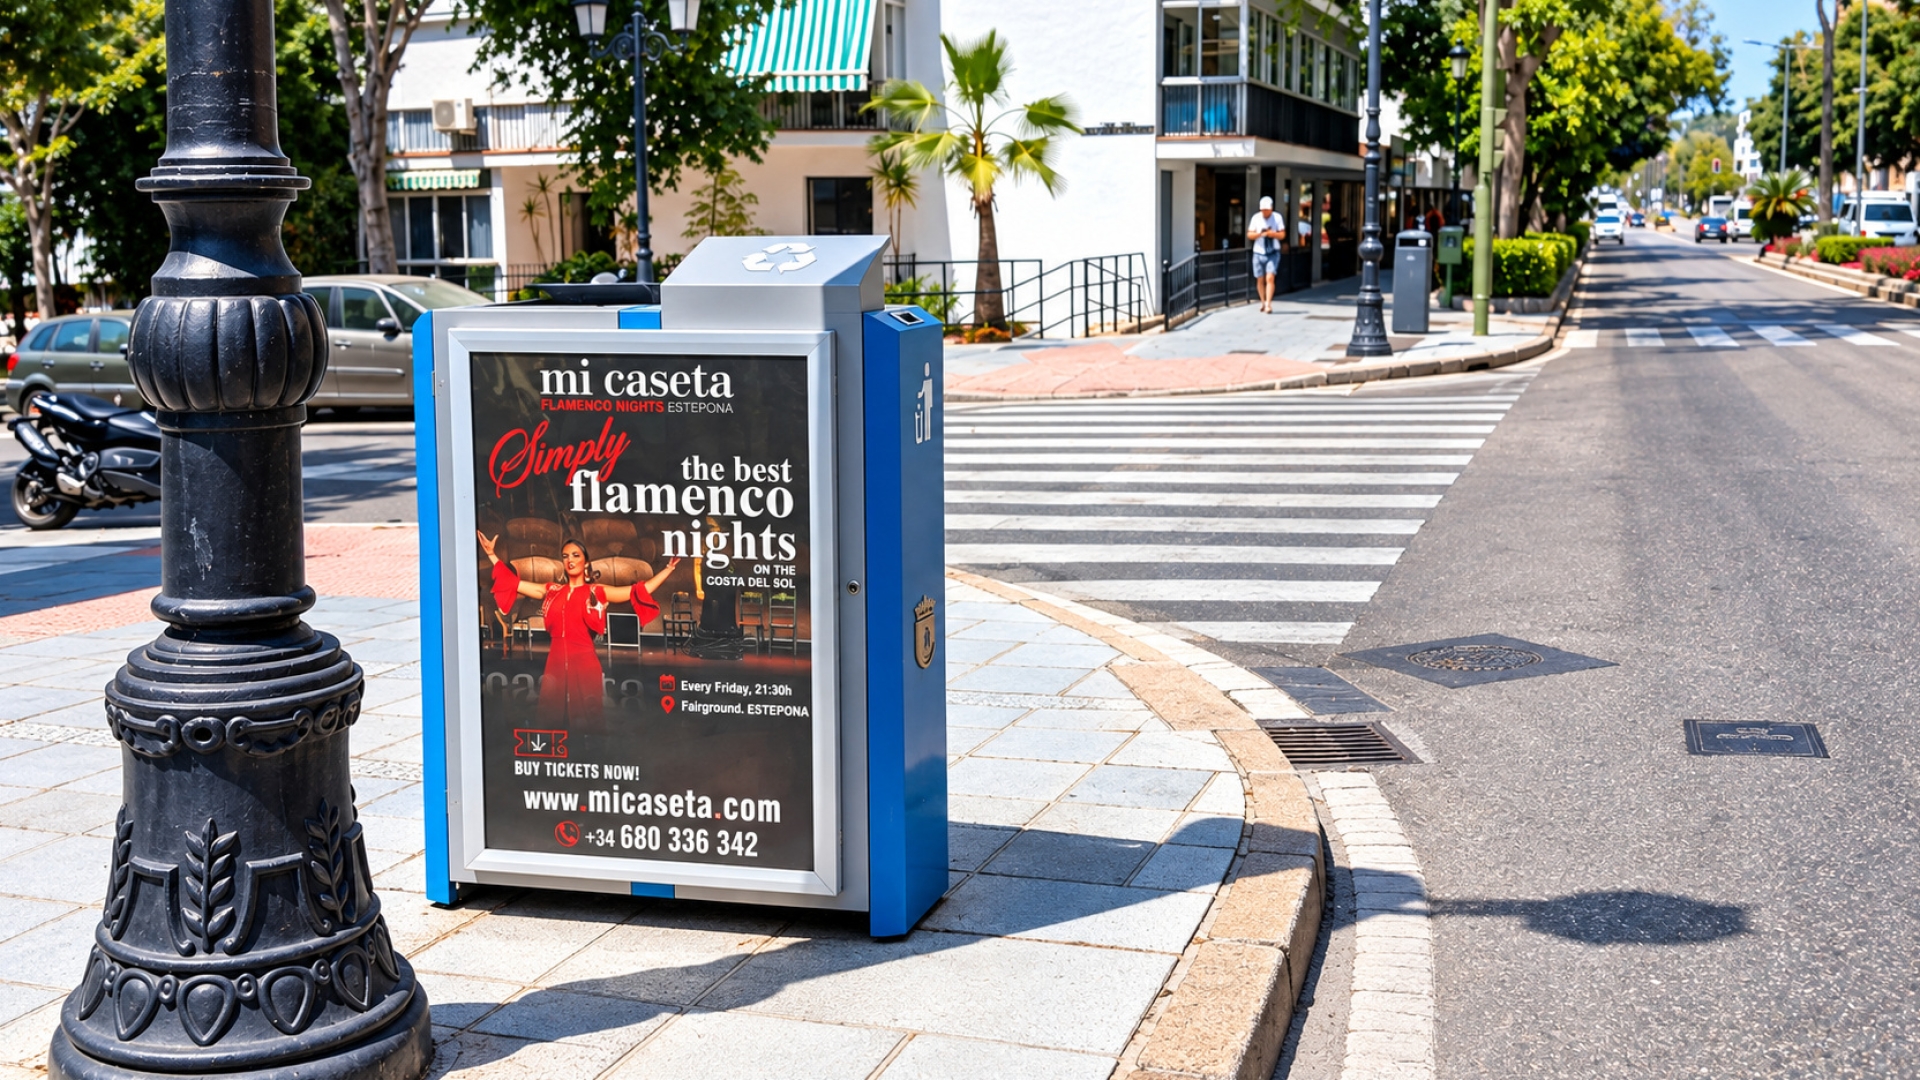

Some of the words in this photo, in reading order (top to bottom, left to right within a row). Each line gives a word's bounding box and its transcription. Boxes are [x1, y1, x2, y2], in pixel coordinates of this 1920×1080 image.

[540, 358, 593, 396] mi
[603, 364, 734, 398] caseta
[541, 399, 612, 412] FLAMENCO
[615, 400, 664, 413] NIGHTS
[668, 402, 734, 413] ESTEPONA
[488, 416, 631, 498] Simply
[681, 455, 725, 481] the
[733, 456, 793, 483] best
[570, 469, 794, 518] flamenco
[662, 519, 797, 569] nights
[706, 576, 745, 587] COSTA
[748, 578, 770, 588] DEL
[773, 578, 796, 589] SOL
[753, 565, 770, 575] ON
[773, 565, 796, 576] THE
[681, 680, 712, 695] Every
[714, 681, 752, 697] Friday,
[755, 683, 793, 696] 21:30h
[747, 704, 810, 718] ESTEPONA
[514, 760, 540, 776] BUY
[544, 762, 600, 779] TICKETS
[603, 765, 640, 781] NOW!
[523, 784, 781, 823] www.micaseta.com
[585, 829, 615, 847] +34
[620, 824, 661, 851] 680
[668, 827, 709, 852] 336
[716, 831, 758, 857] 342
